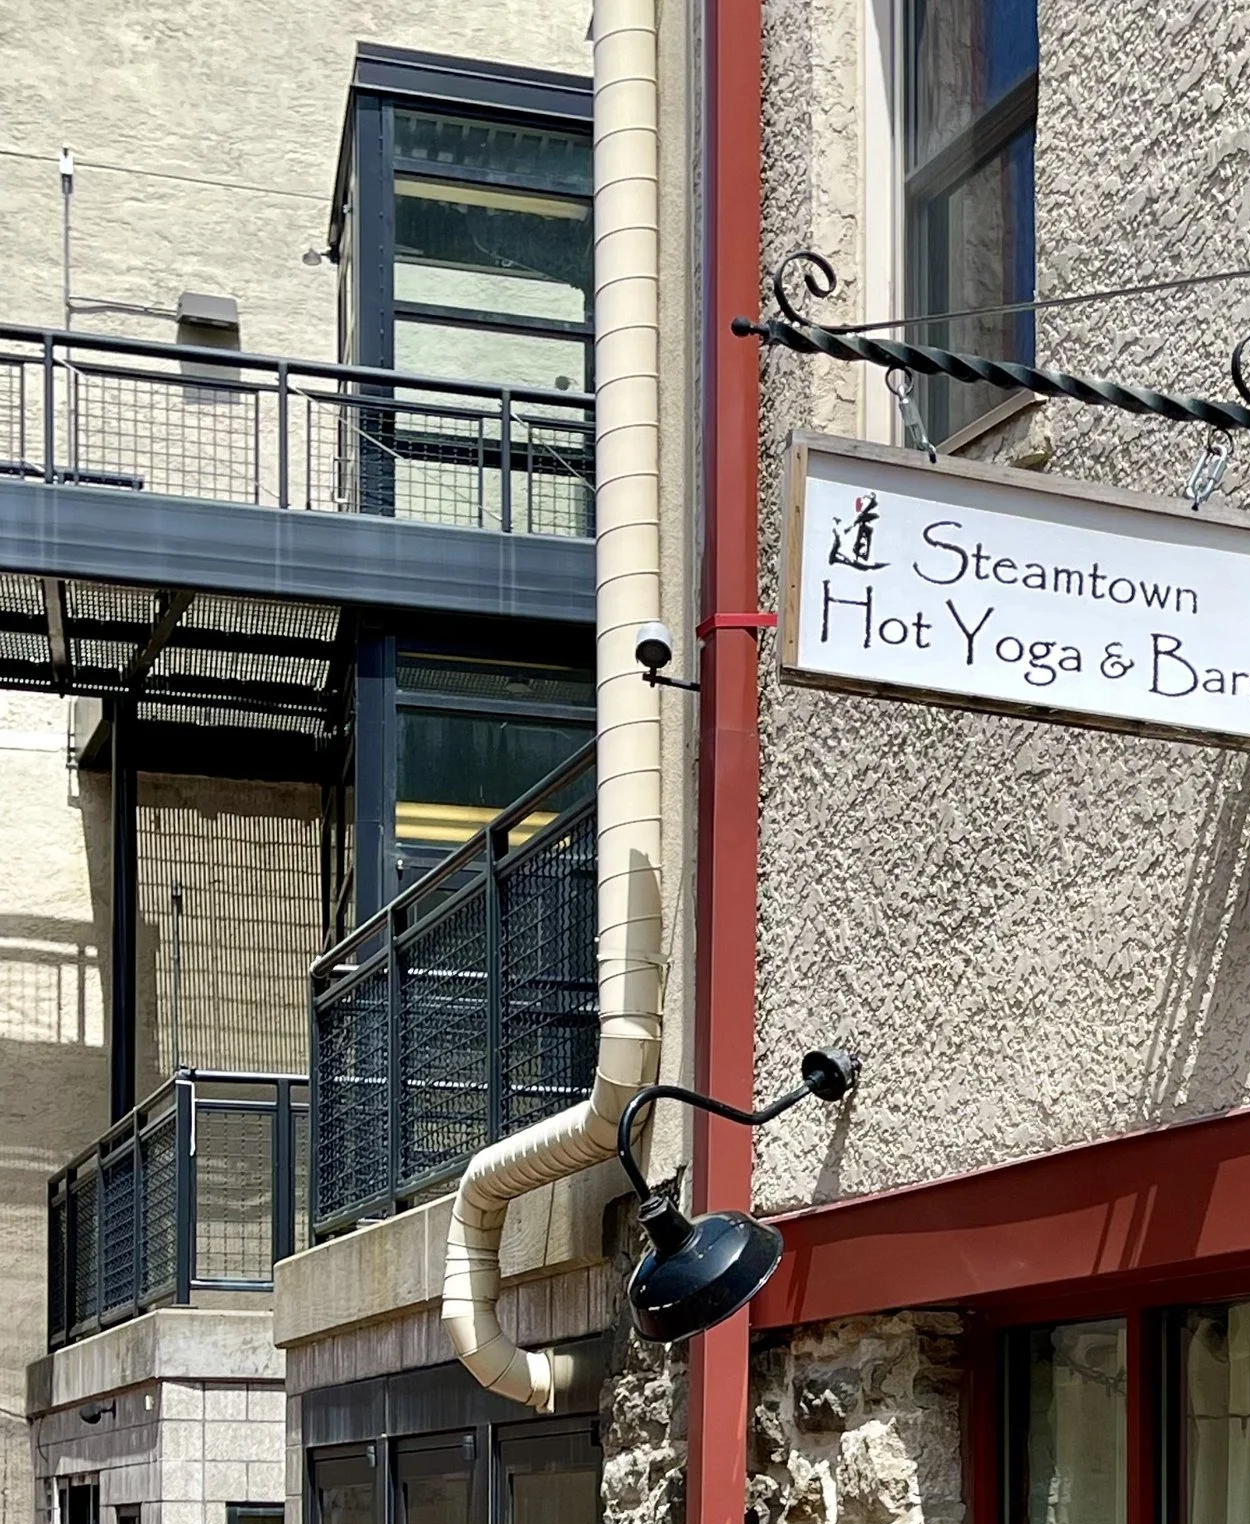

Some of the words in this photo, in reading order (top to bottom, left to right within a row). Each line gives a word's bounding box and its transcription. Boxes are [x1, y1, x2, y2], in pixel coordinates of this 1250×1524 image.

[912, 520, 1199, 615] Steamtown
[820, 579, 933, 649] Hot
[945, 599, 1083, 687] Yoga
[1100, 641, 1136, 680] &
